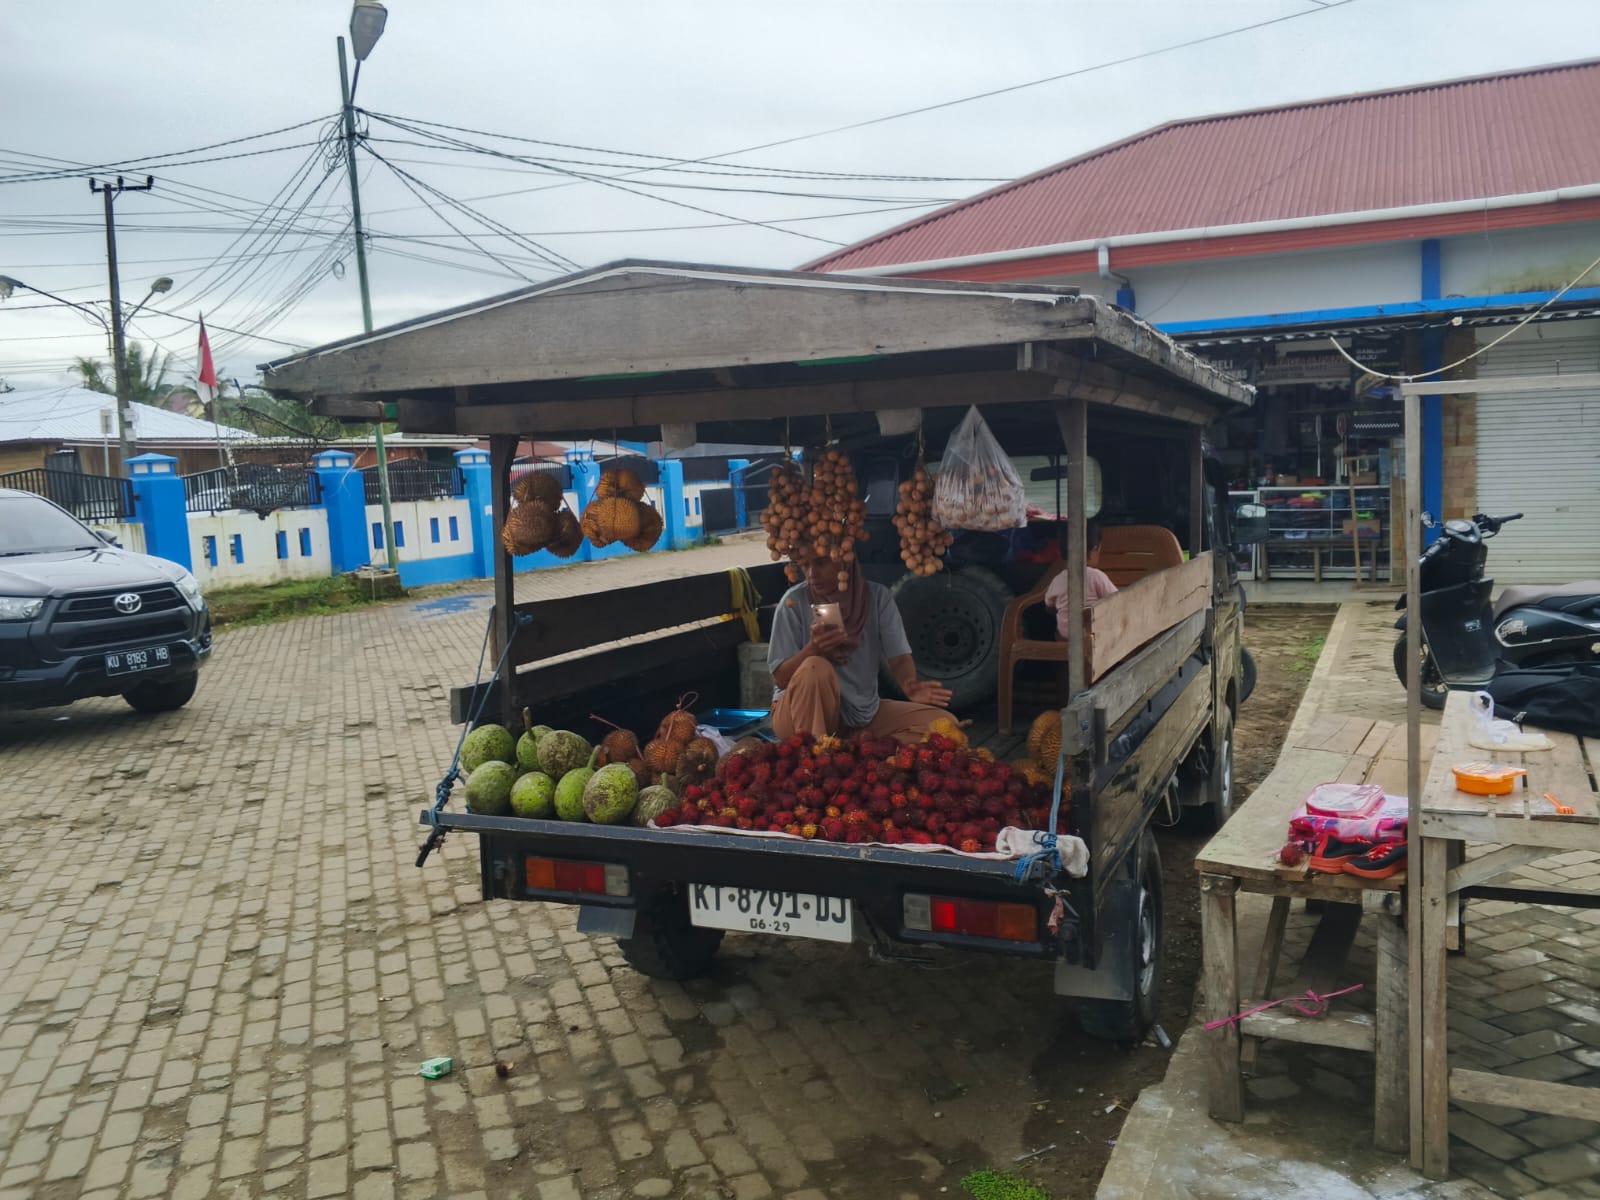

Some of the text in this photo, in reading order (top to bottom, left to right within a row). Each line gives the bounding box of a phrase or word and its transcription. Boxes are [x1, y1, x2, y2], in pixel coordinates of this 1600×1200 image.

[107, 655, 120, 668] KU
[155, 647, 168, 661] HB
[694, 884, 725, 911] KT
[737, 887, 801, 919] 8791
